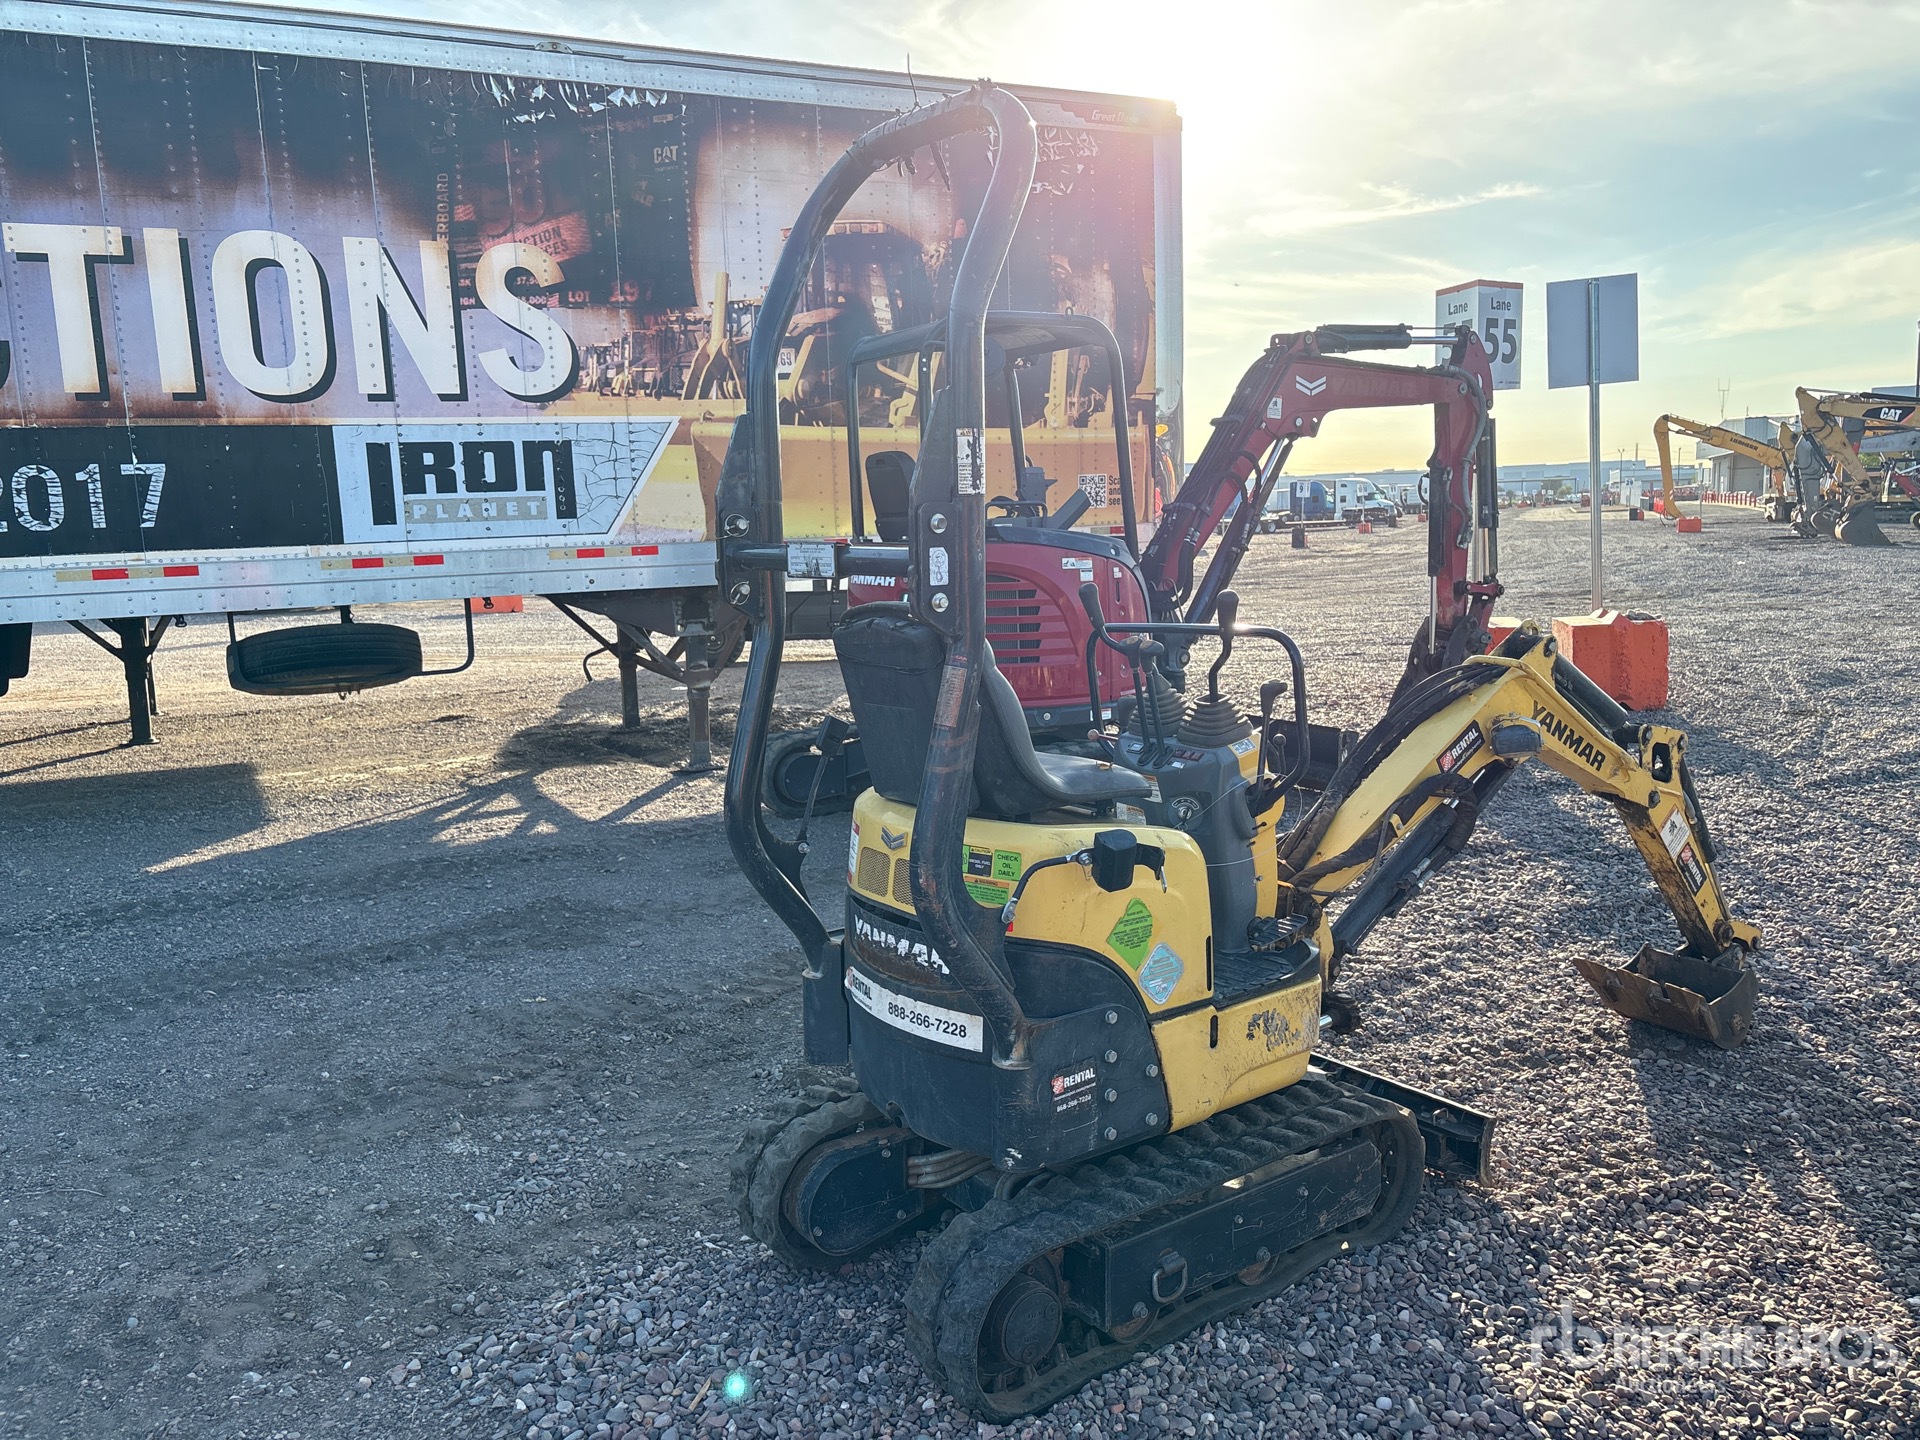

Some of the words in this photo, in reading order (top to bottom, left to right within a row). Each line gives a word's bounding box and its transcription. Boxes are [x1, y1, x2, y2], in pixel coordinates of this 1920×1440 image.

[653, 145, 679, 164] CAT
[0, 221, 580, 402] TIONS
[1447, 302, 1469, 316] Lane
[1490, 296, 1512, 312] Lane
[1484, 317, 1517, 365] 55
[780, 351, 793, 367] 69
[1879, 406, 1902, 422] CAT
[366, 439, 578, 526] IRON
[0, 462, 166, 532] 017
[412, 501, 541, 520] PLANET
[1451, 727, 1479, 760] RENTAL
[1531, 699, 1606, 772] YANMAR
[996, 853, 1019, 863] CHECK
[1001, 862, 1013, 870] OIL
[997, 869, 1016, 877] DAILY
[1687, 856, 1703, 887] RENTAL
[852, 974, 873, 1001] RENTAL
[887, 1001, 968, 1038] 888-266-7228
[1063, 1067, 1096, 1089] RENTAL
